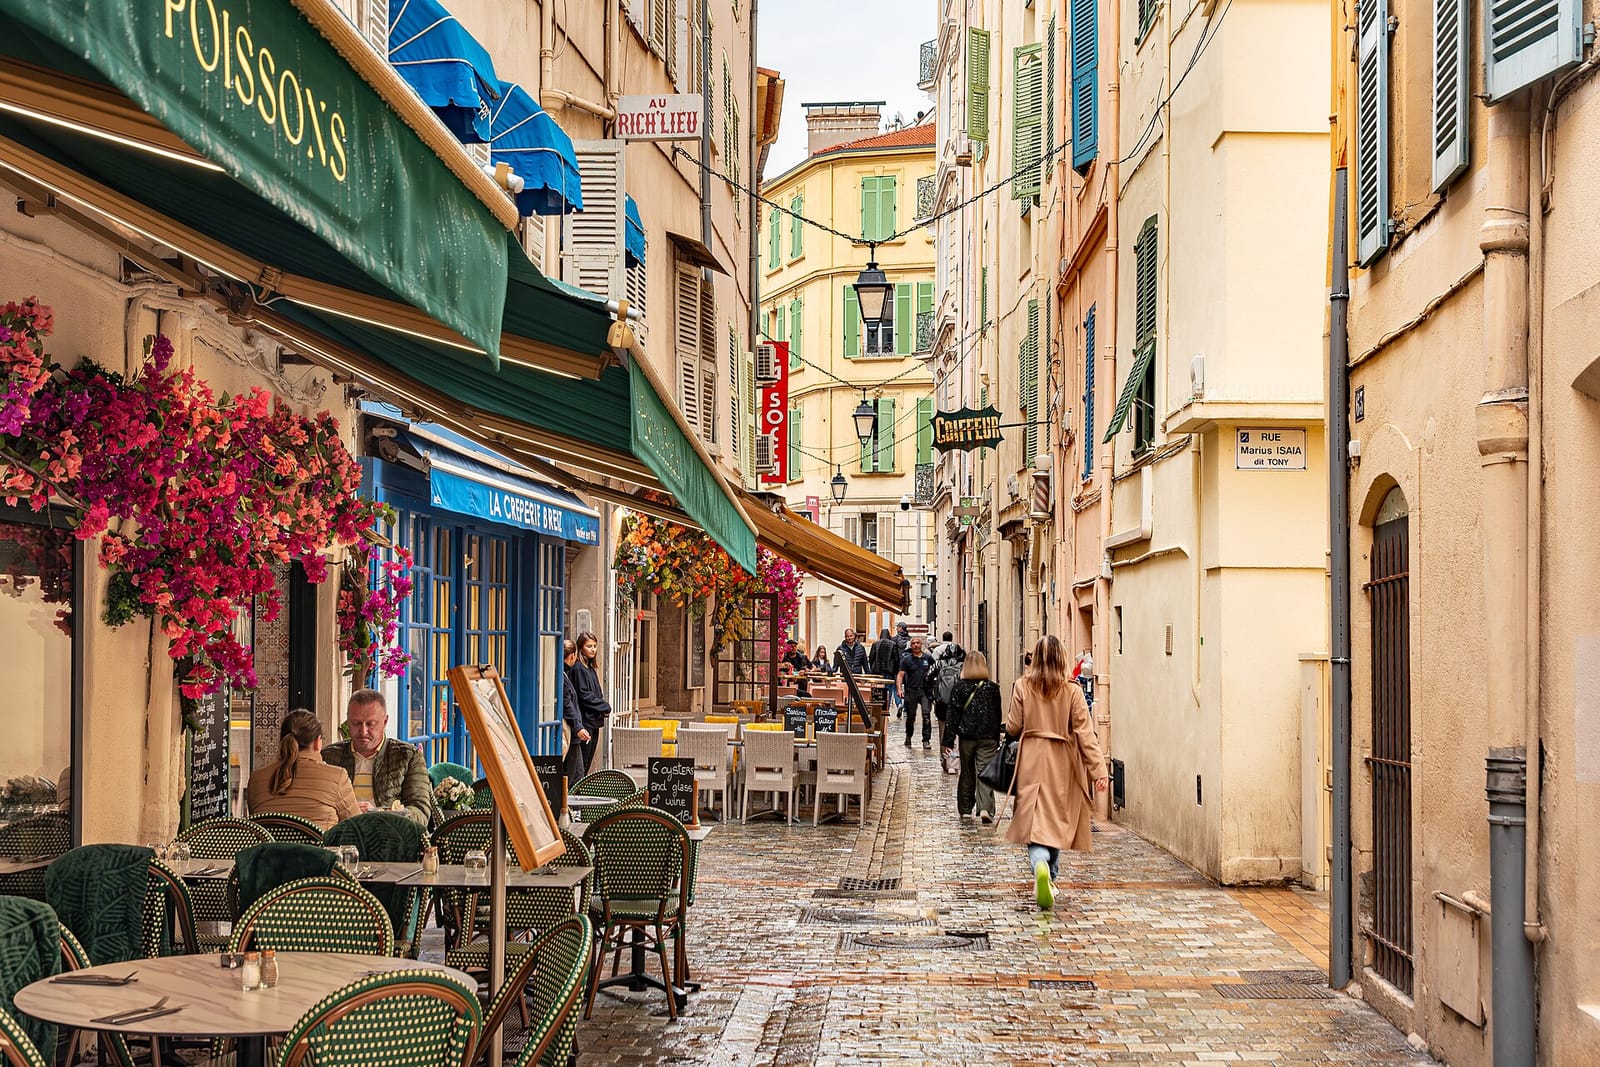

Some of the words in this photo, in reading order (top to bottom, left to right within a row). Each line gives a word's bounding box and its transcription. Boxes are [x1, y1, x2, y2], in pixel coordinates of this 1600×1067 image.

[649, 98, 667, 108] AU
[618, 110, 698, 135] RICH'LIEU
[935, 416, 1001, 444] COIFFEUR
[1261, 433, 1281, 441] RUE
[1240, 446, 1272, 454] Marius
[1276, 446, 1302, 454] ISAIA
[1268, 458, 1289, 466] TONY
[489, 490, 502, 517] LA
[503, 495, 541, 527] CREPERIE
[651, 761, 660, 774] 6
[650, 779, 667, 791] and
[672, 779, 693, 797] glass
[650, 793, 661, 804] of
